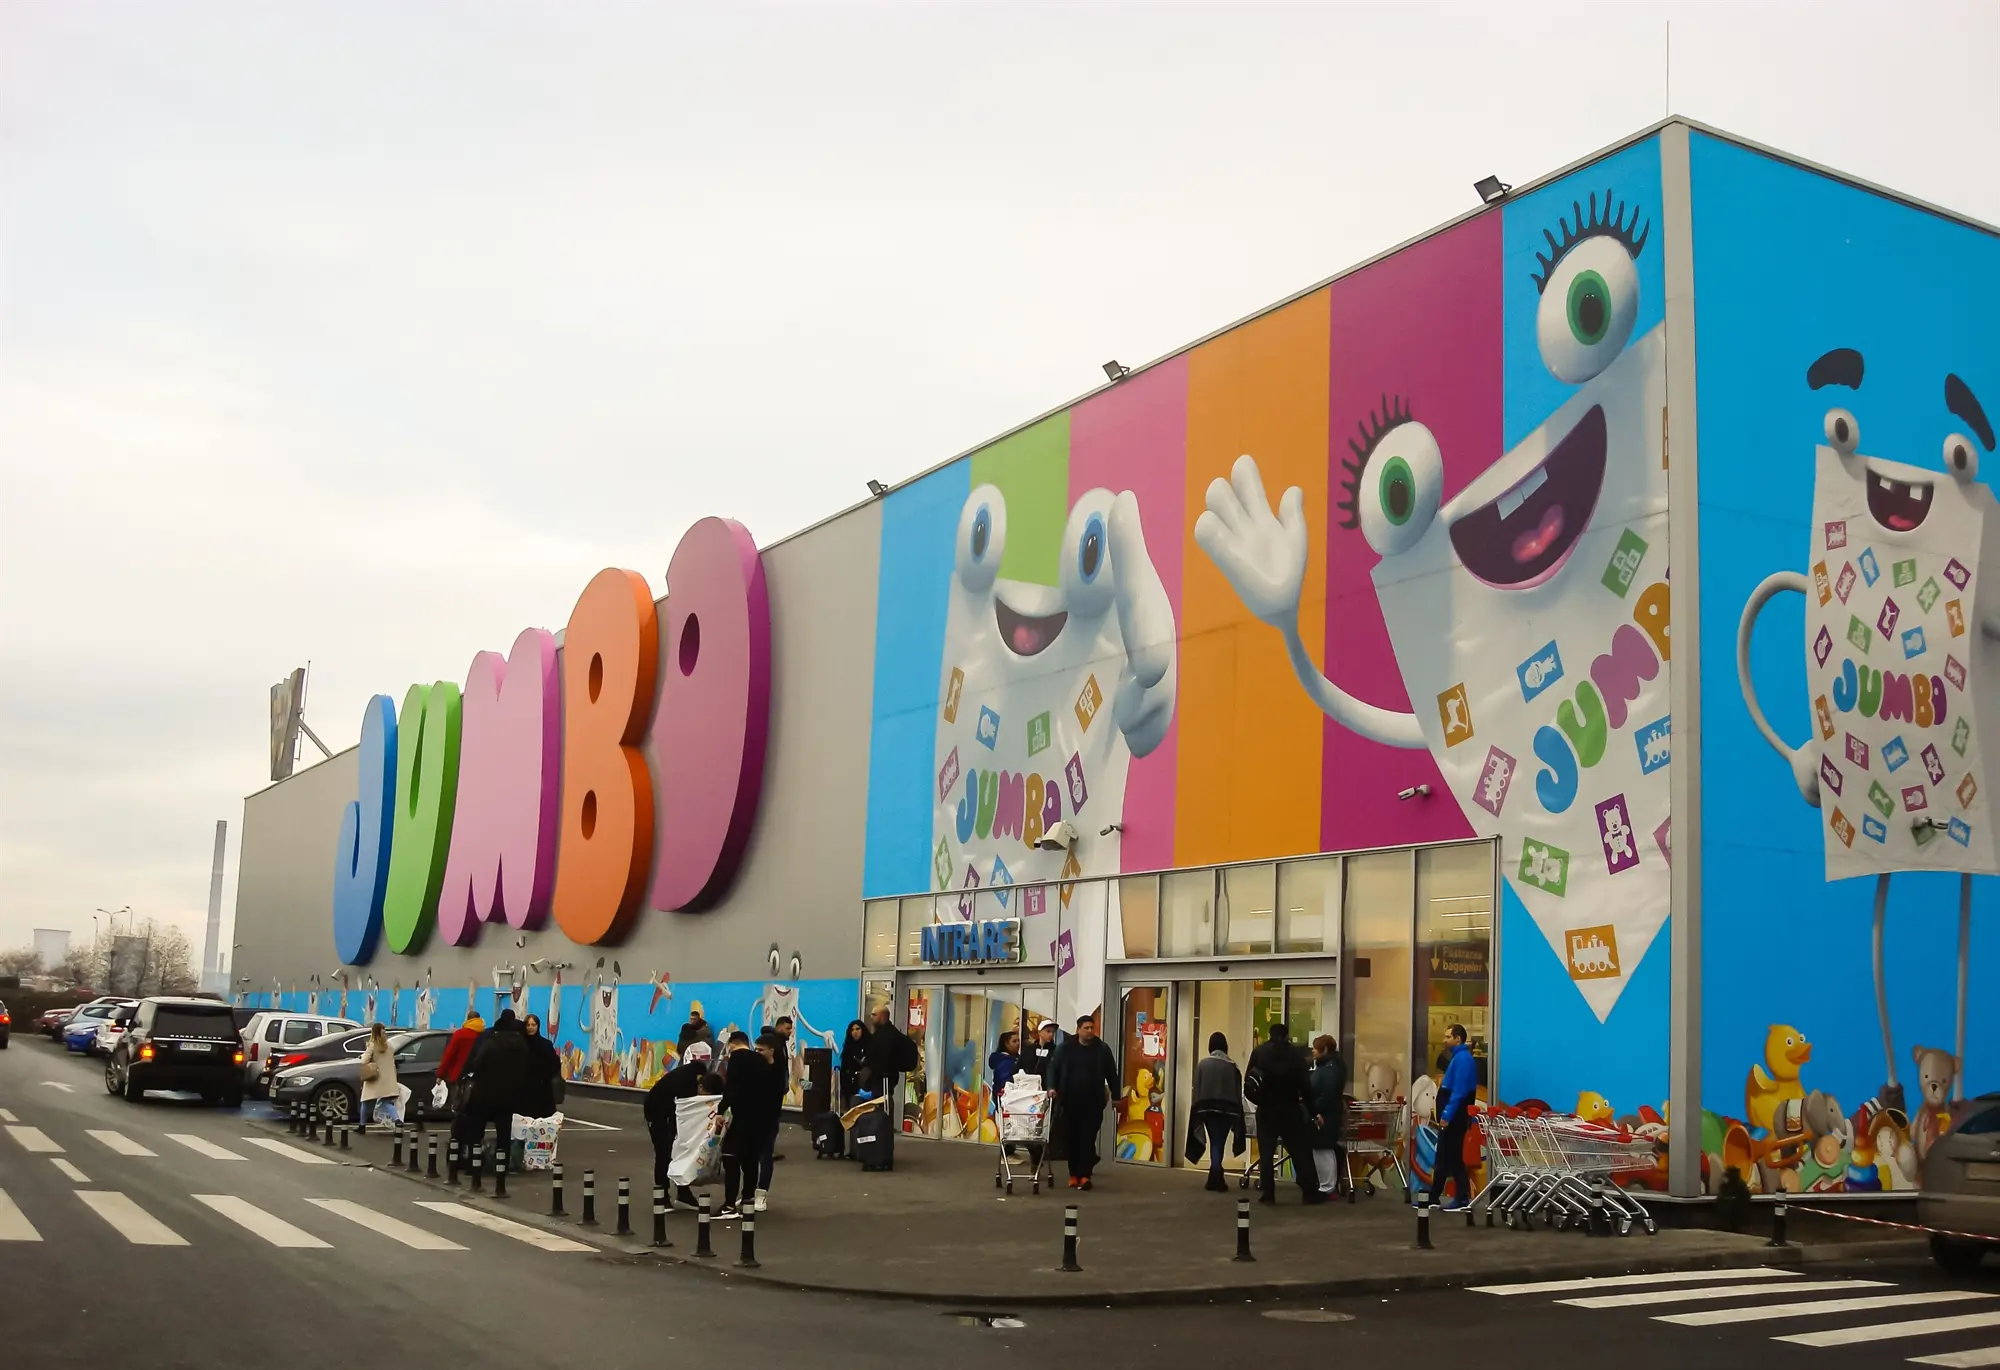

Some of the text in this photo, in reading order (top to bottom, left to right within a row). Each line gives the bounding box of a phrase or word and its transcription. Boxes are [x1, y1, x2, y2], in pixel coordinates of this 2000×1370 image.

[1533, 567, 1671, 814] JUMB
[1833, 658, 1948, 728] JUMBO
[333, 516, 771, 966] JUMBO
[956, 768, 1063, 851] JUMBO
[920, 919, 1019, 965] INTRARE
